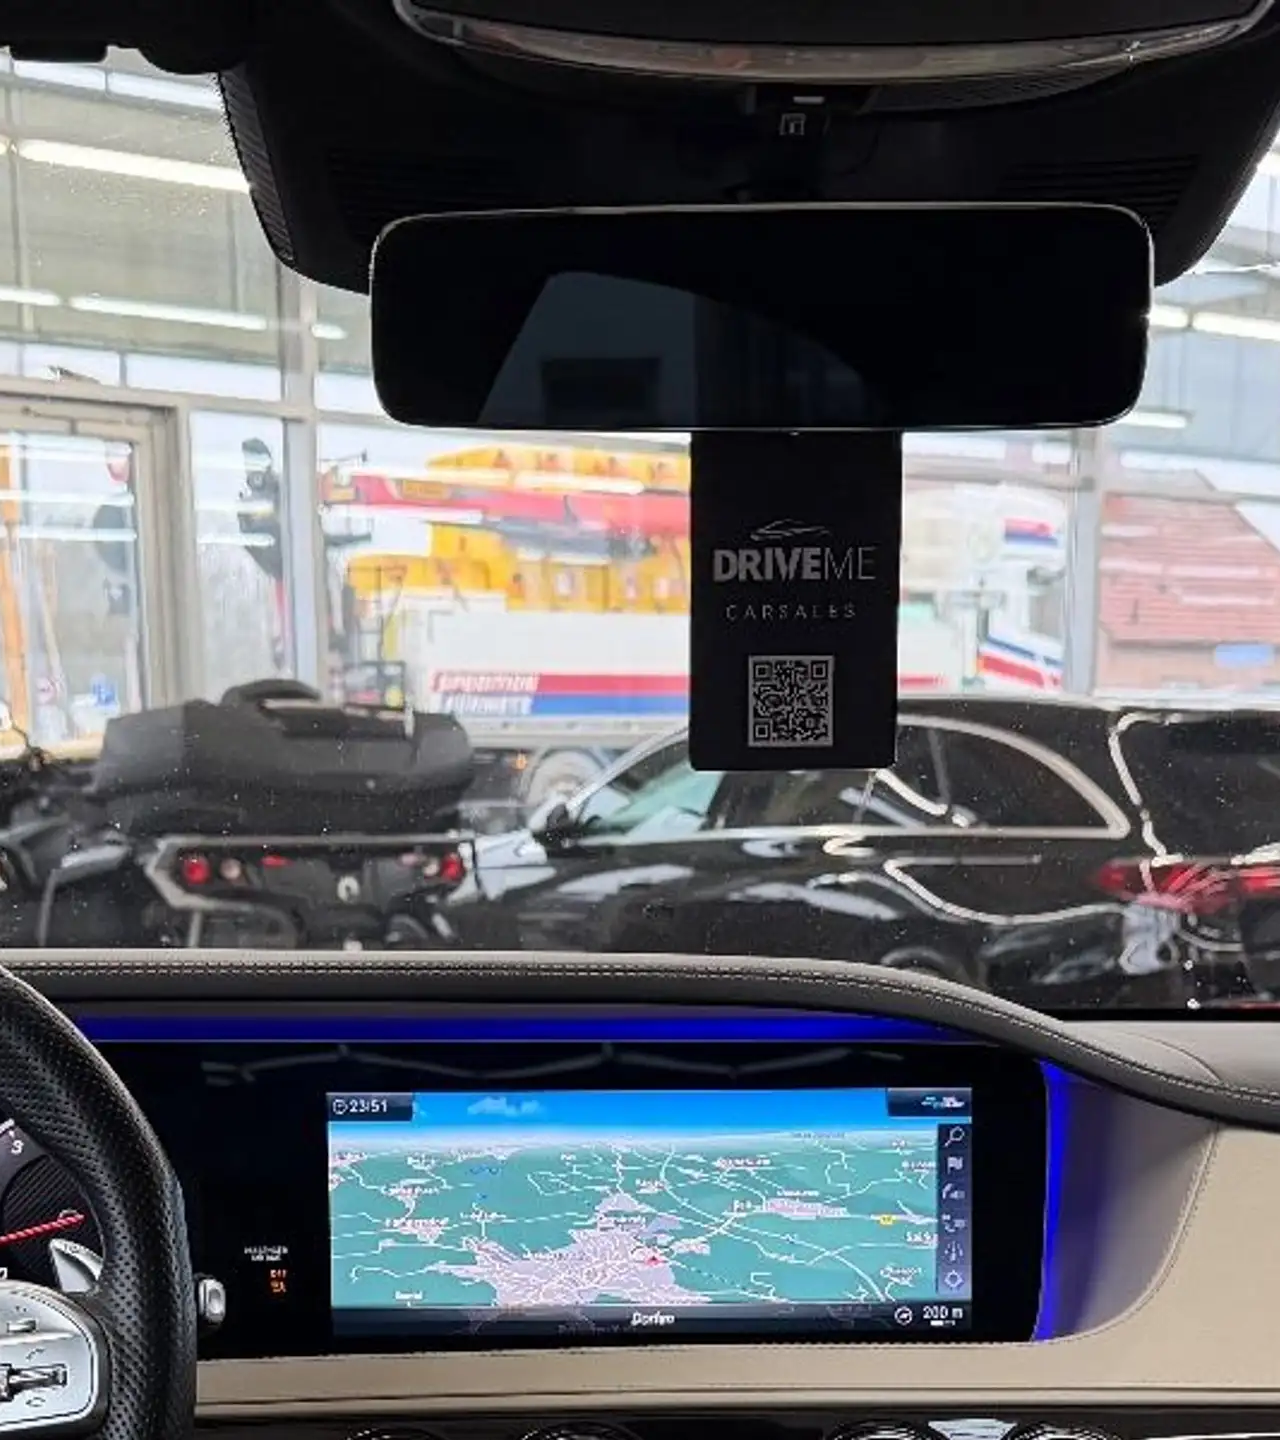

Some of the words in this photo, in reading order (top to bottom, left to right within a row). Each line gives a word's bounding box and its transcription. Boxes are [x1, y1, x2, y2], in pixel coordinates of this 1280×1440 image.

[713, 547, 877, 581] DRIVEME
[726, 604, 857, 621] CARSALES
[349, 1098, 388, 1114] 23:51
[11, 1140, 24, 1154] 3
[923, 1306, 949, 1320] 200
